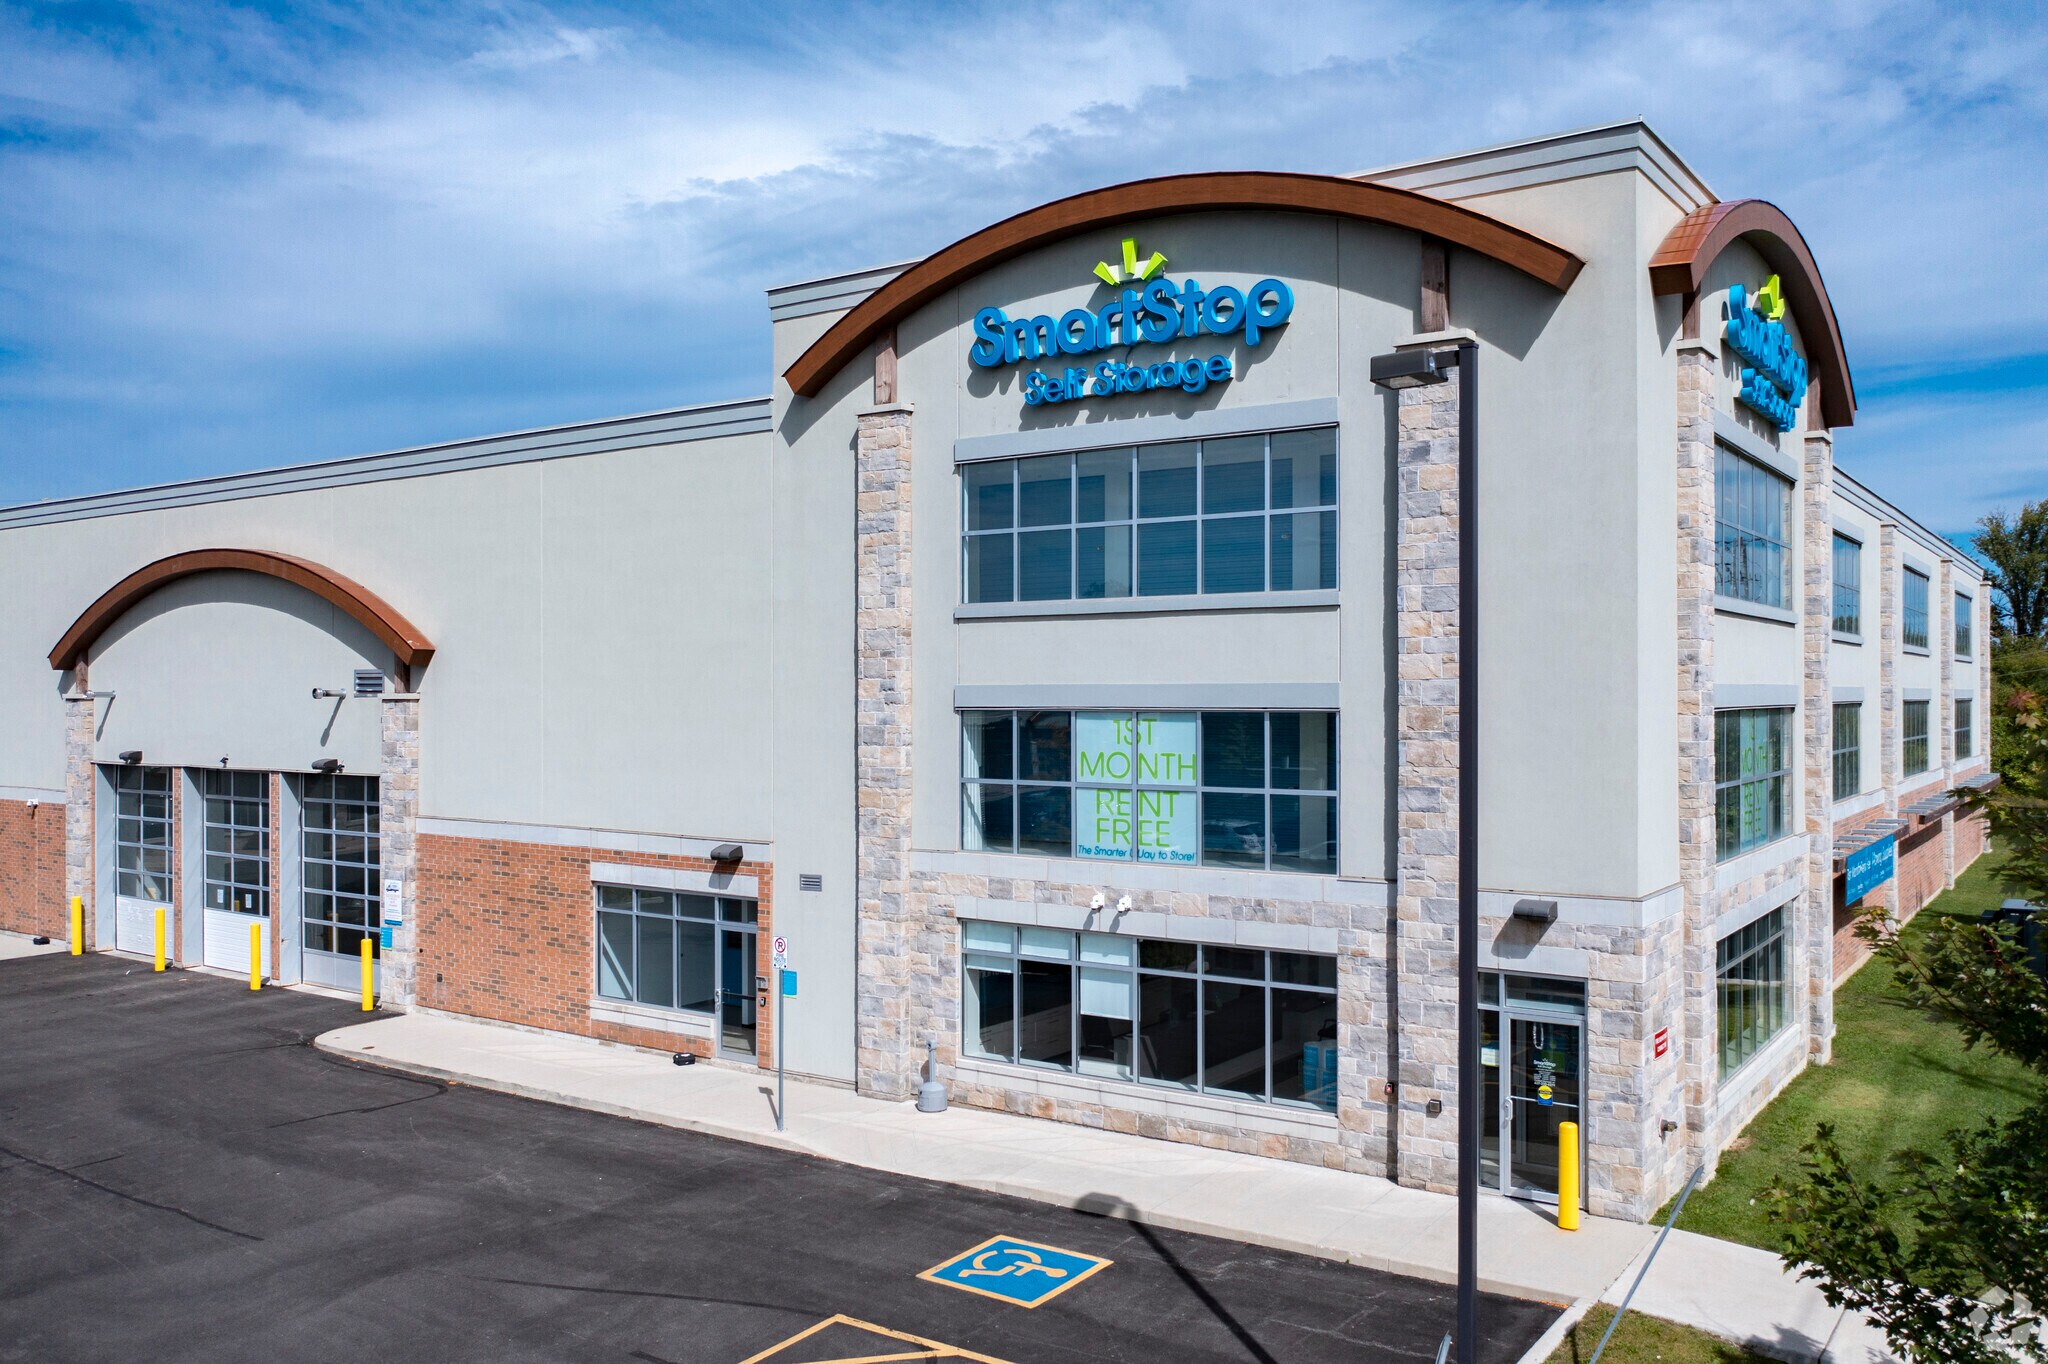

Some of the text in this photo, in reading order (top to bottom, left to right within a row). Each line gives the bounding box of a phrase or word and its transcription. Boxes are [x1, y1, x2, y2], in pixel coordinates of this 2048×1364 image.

[972, 278, 1294, 367] SmartStop
[1025, 355, 1233, 406] Self Storage
[1113, 718, 1157, 745] 1ST
[1080, 751, 1196, 781] MONTH
[1096, 788, 1180, 818] RENT
[1096, 817, 1170, 847] FREE
[1078, 844, 1092, 855] The
[1094, 845, 1127, 858] Smarter
[1158, 851, 1168, 861] to
[1170, 850, 1195, 862] Store!
